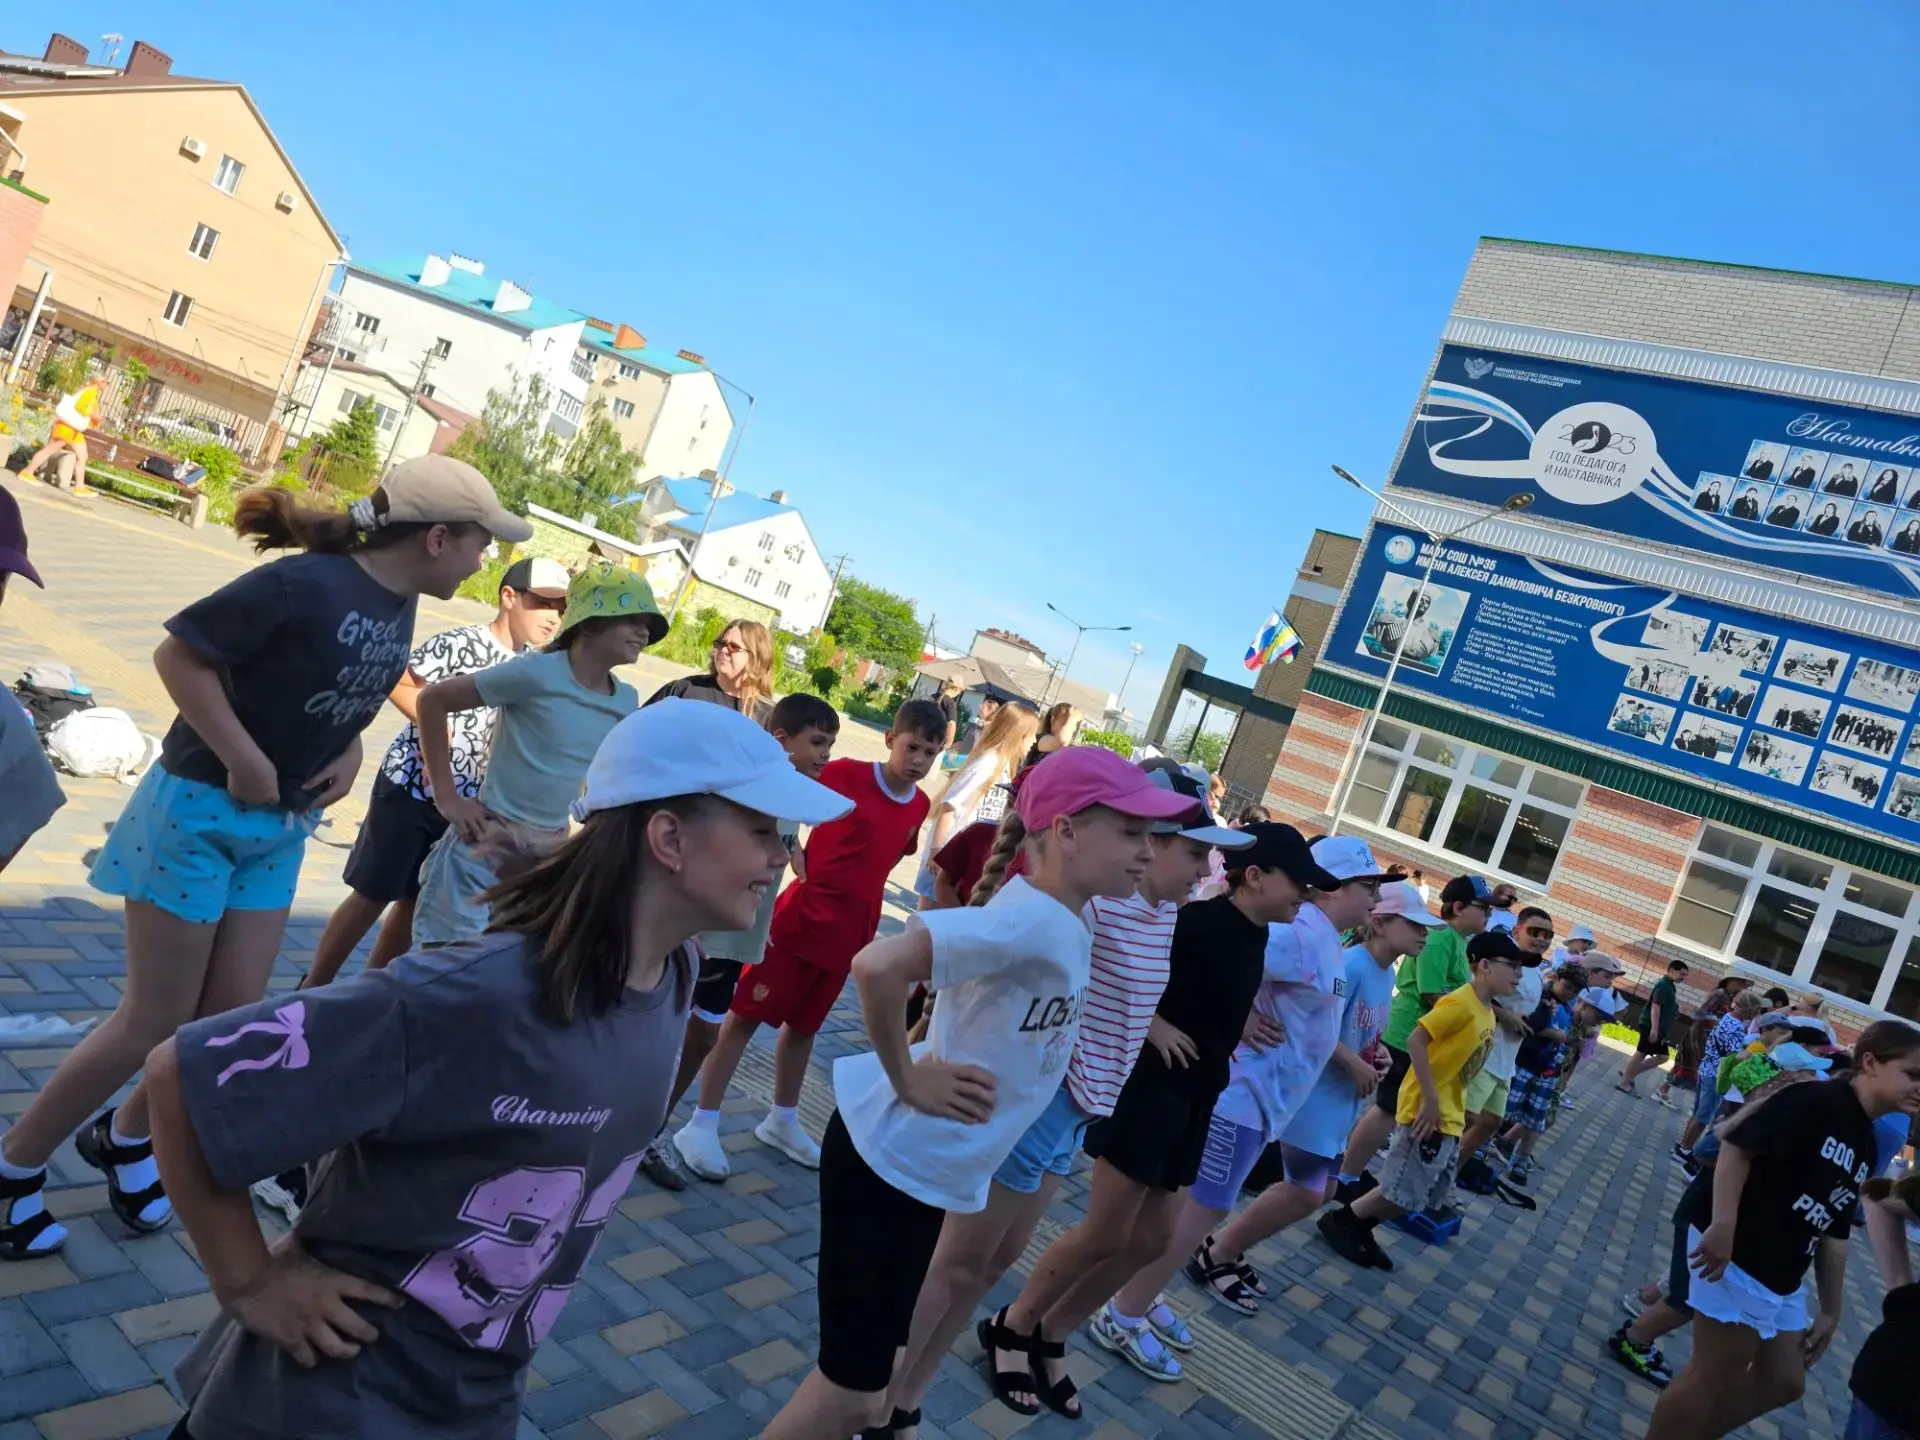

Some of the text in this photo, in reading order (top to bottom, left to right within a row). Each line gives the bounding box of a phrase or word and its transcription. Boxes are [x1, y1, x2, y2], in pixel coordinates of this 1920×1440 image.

[1550, 449, 1627, 474] ГОД ПЕДАГОГА
[1544, 464, 1623, 488] И НАСТАВНИКА
[1446, 549, 1468, 564] СОШ
[1415, 555, 1626, 617] ИМЕНИ АЛЕКСЕЯ ДАНИЛОВИЧА БЕЗКРОВНОГО
[361, 641, 410, 672] energ
[490, 1094, 613, 1134] Charming
